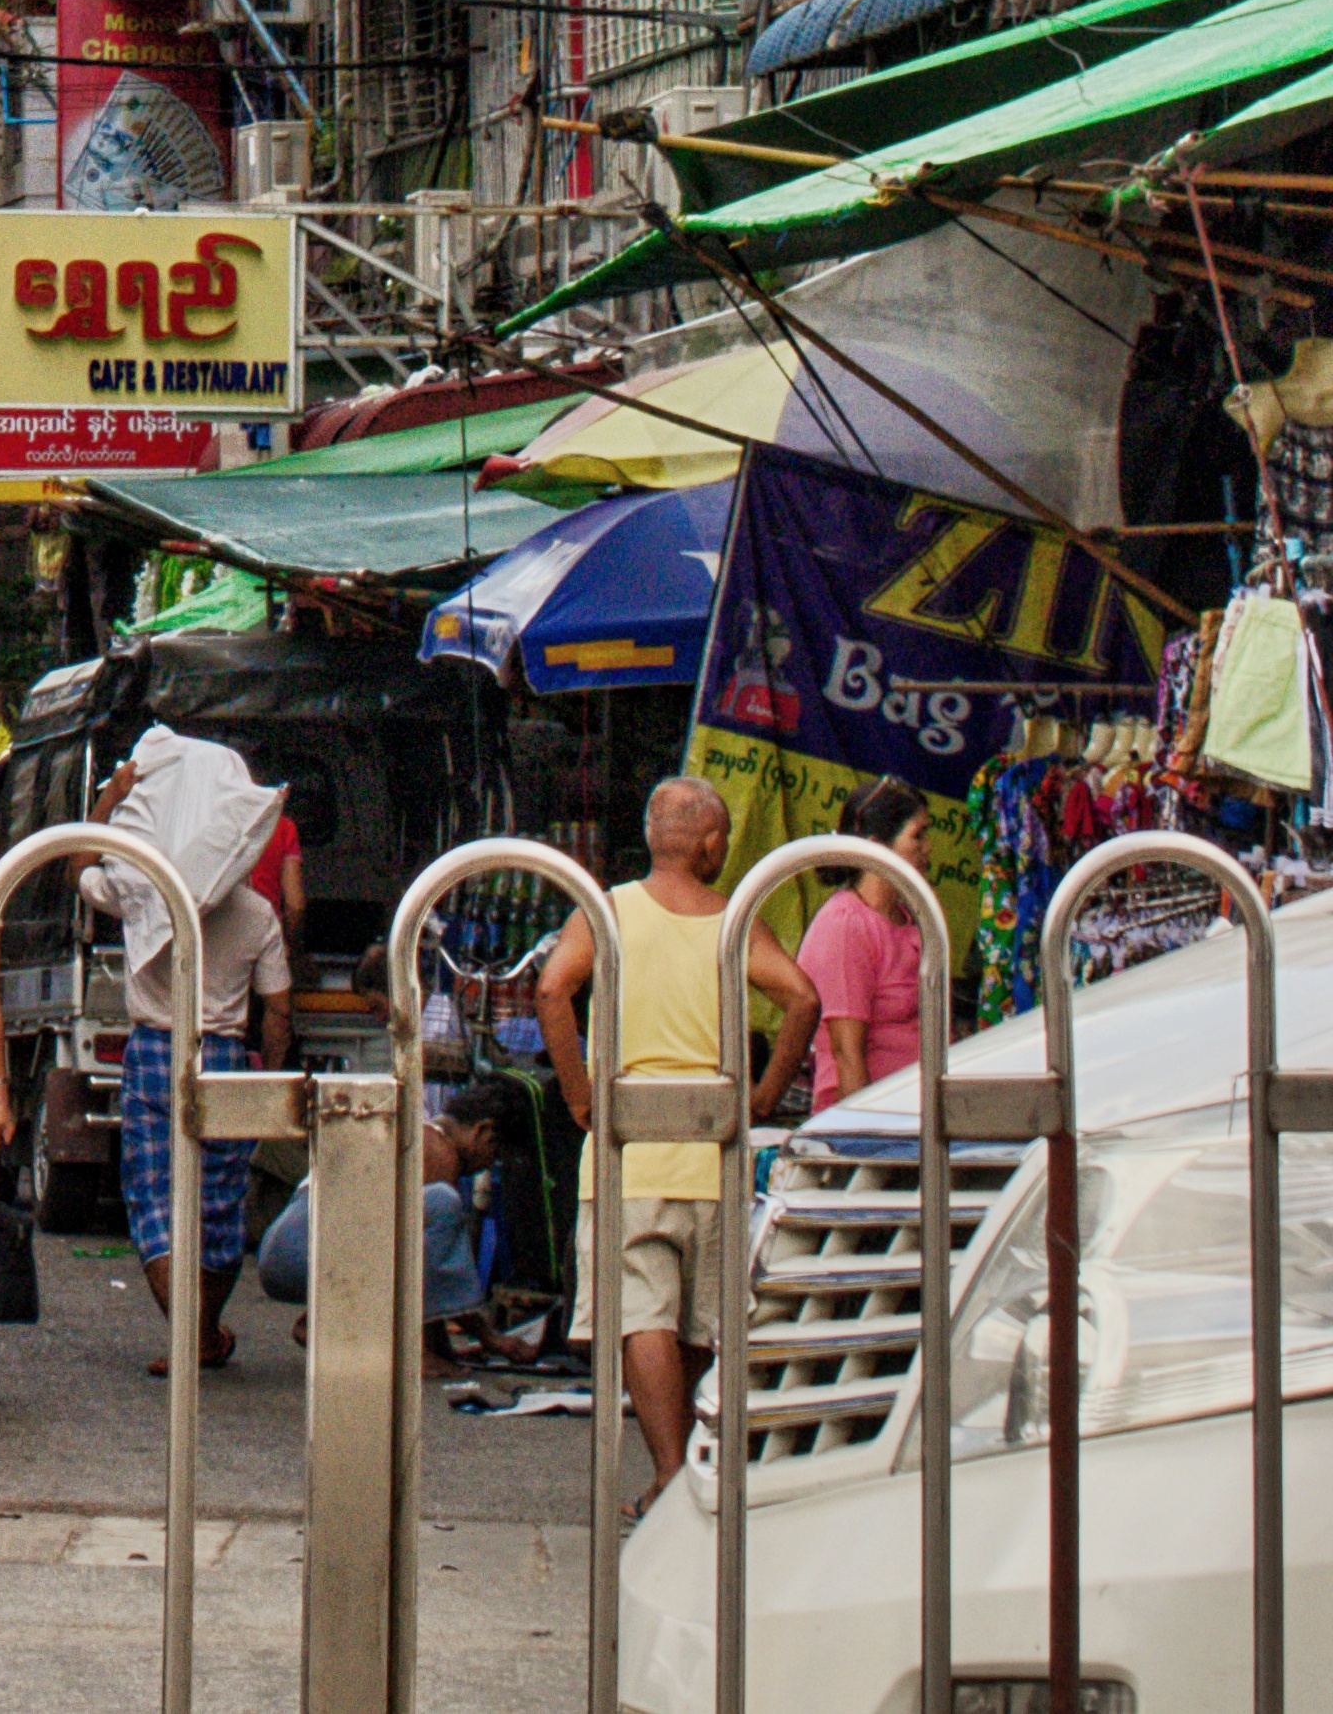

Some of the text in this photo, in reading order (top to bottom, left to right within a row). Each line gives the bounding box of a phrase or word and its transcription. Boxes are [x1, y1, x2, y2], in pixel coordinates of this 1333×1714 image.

[89, 359, 289, 394] CAFE & RESTAURANT
[822, 634, 971, 755] Bag
